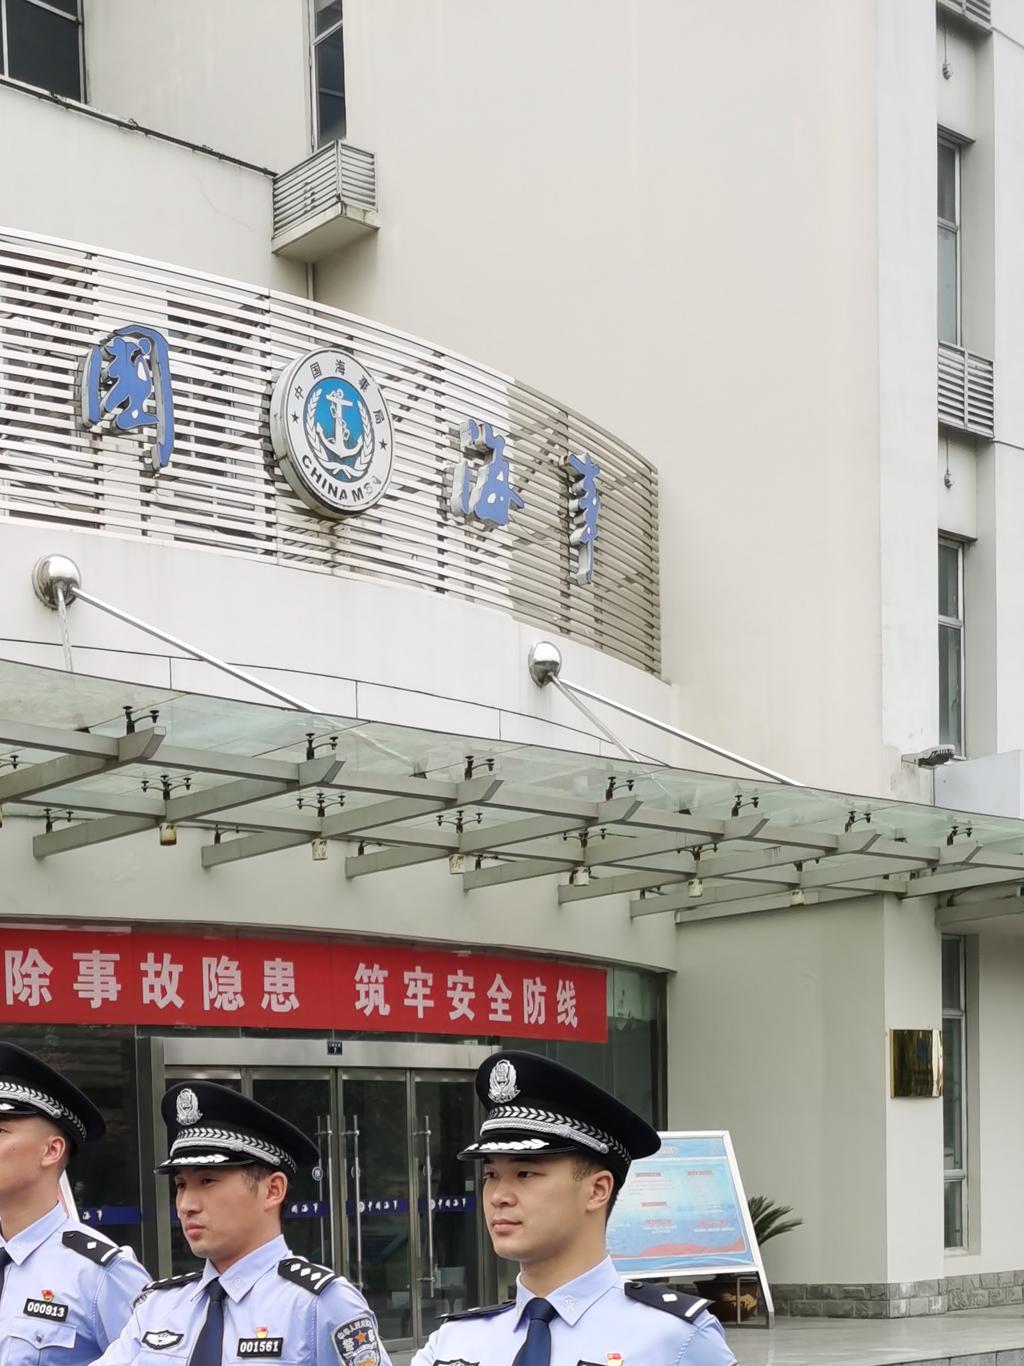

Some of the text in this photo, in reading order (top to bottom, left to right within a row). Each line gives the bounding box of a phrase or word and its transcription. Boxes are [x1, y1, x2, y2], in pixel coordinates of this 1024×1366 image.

[294, 359, 385, 425] 中国海事局
[302, 454, 348, 501] CHINA
[354, 962, 578, 1028] 筑牢安全防线
[27, 1302, 65, 1318] 000913
[239, 1340, 279, 1353] 001561
